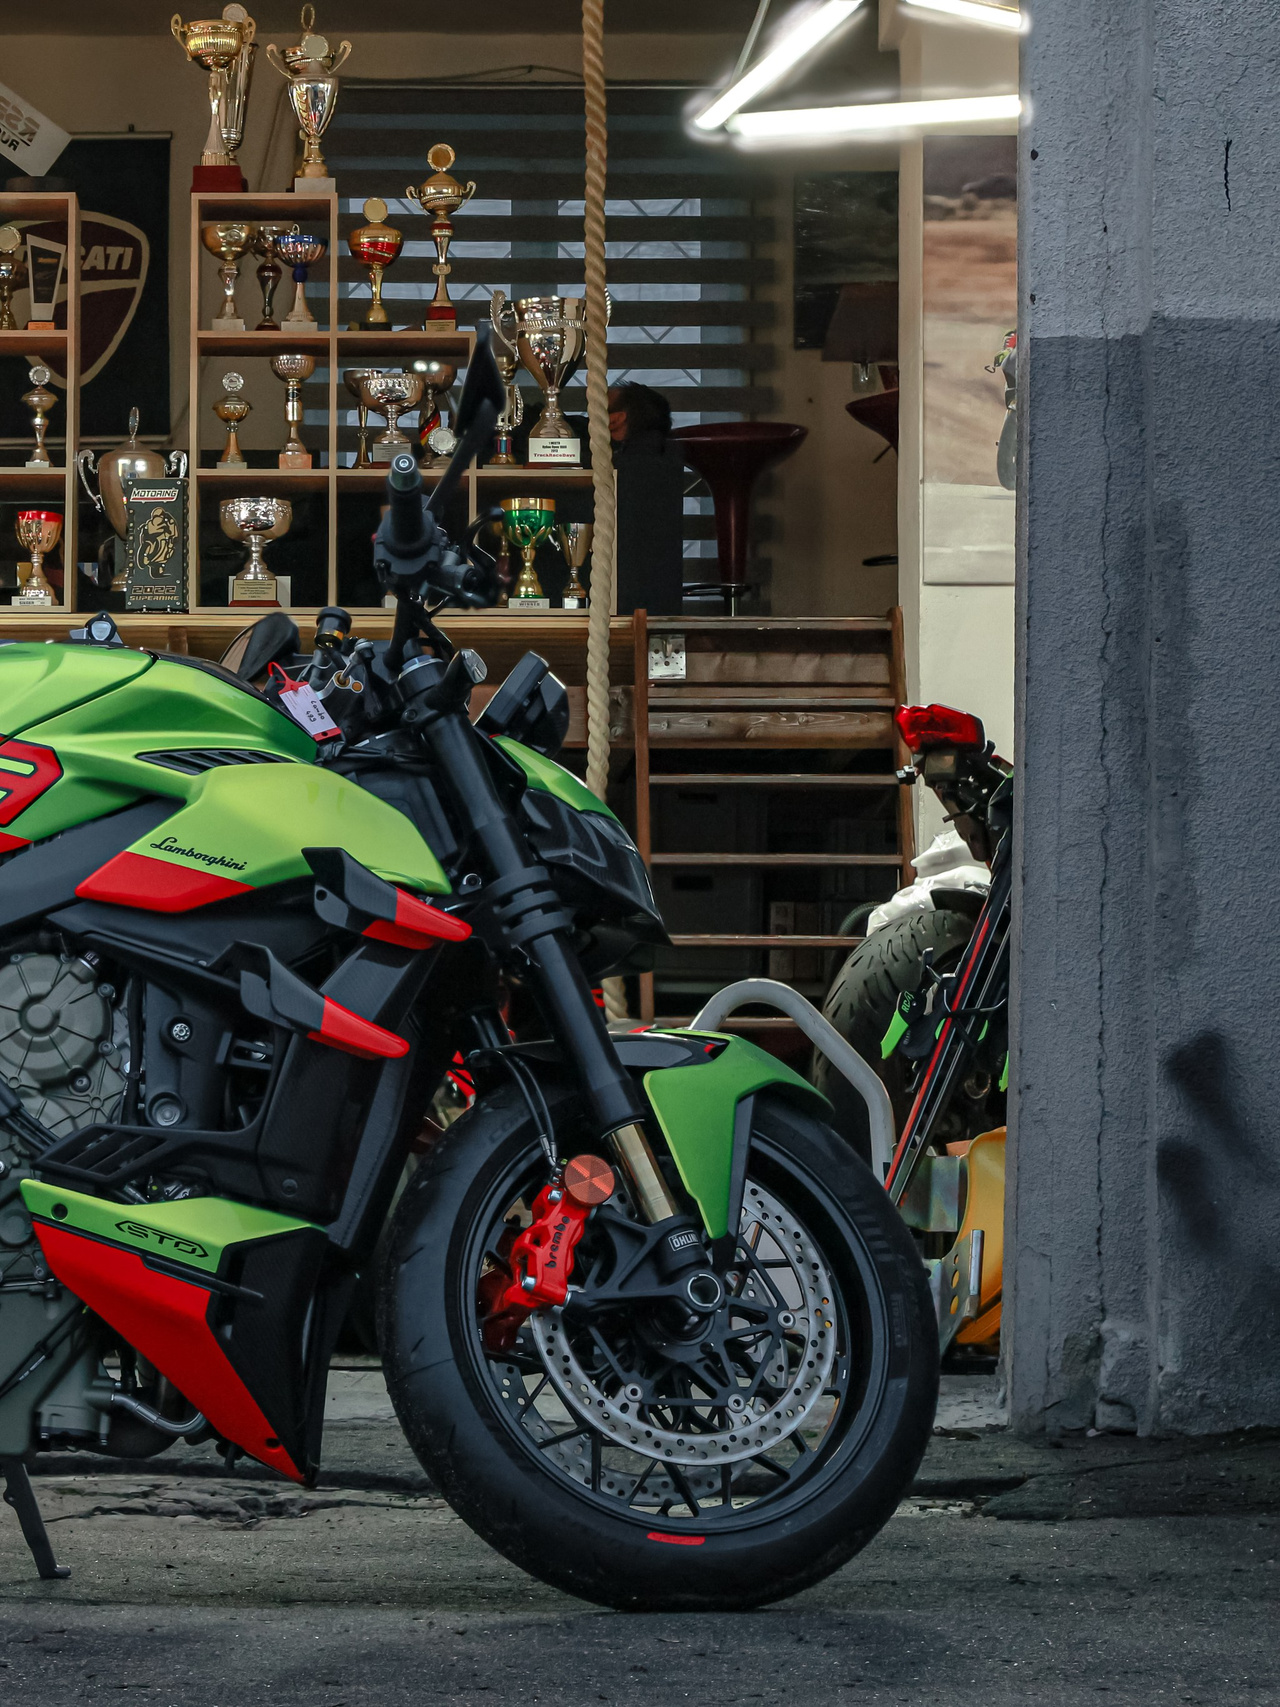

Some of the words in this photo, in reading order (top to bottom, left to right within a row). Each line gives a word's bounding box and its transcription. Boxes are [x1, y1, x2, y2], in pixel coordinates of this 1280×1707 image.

[131, 489, 178, 498] MOTORING
[131, 585, 177, 595] 2022
[150, 836, 248, 871] Lamborghini
[544, 1215, 570, 1269] brembo
